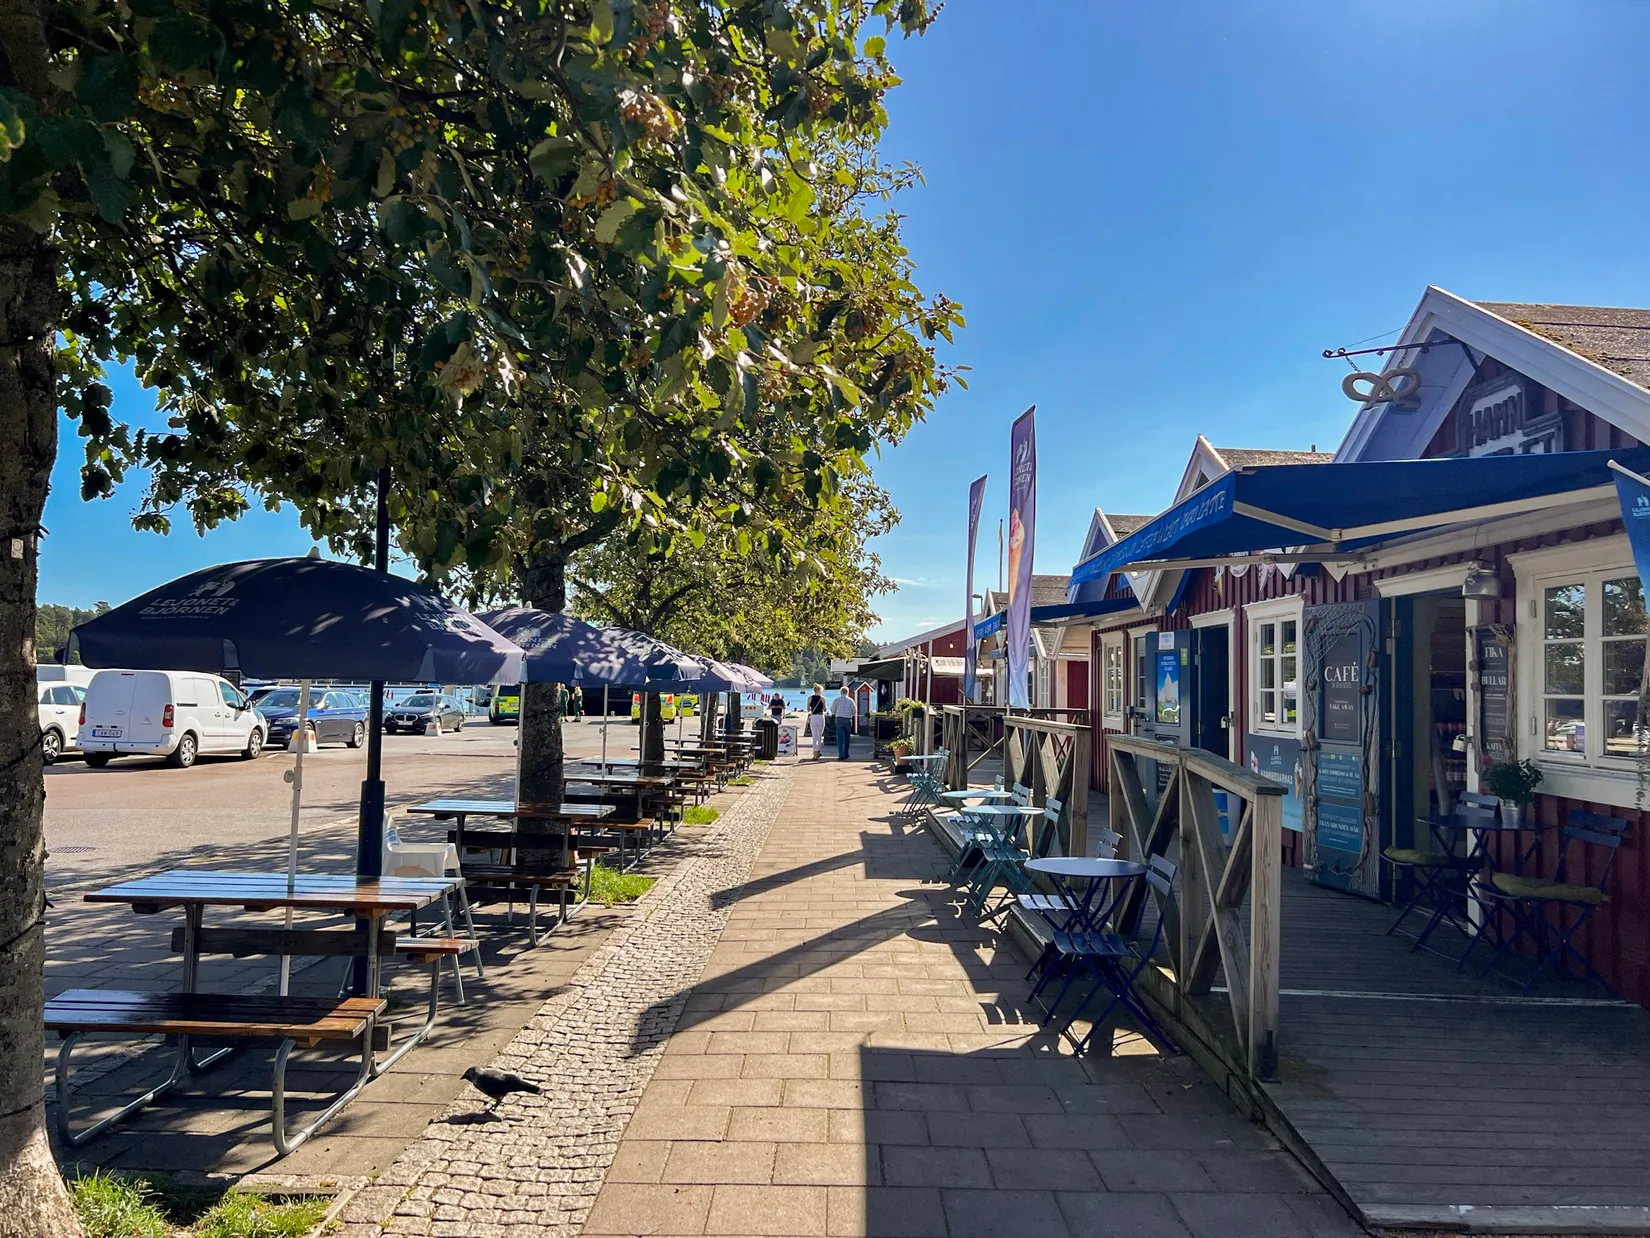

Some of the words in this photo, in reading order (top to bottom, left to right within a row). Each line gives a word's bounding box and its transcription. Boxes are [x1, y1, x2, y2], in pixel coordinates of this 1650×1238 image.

[138, 605, 229, 615] BJÖRNEN
[1485, 646, 1504, 658] FIKA
[1481, 676, 1507, 686] BULLAR
